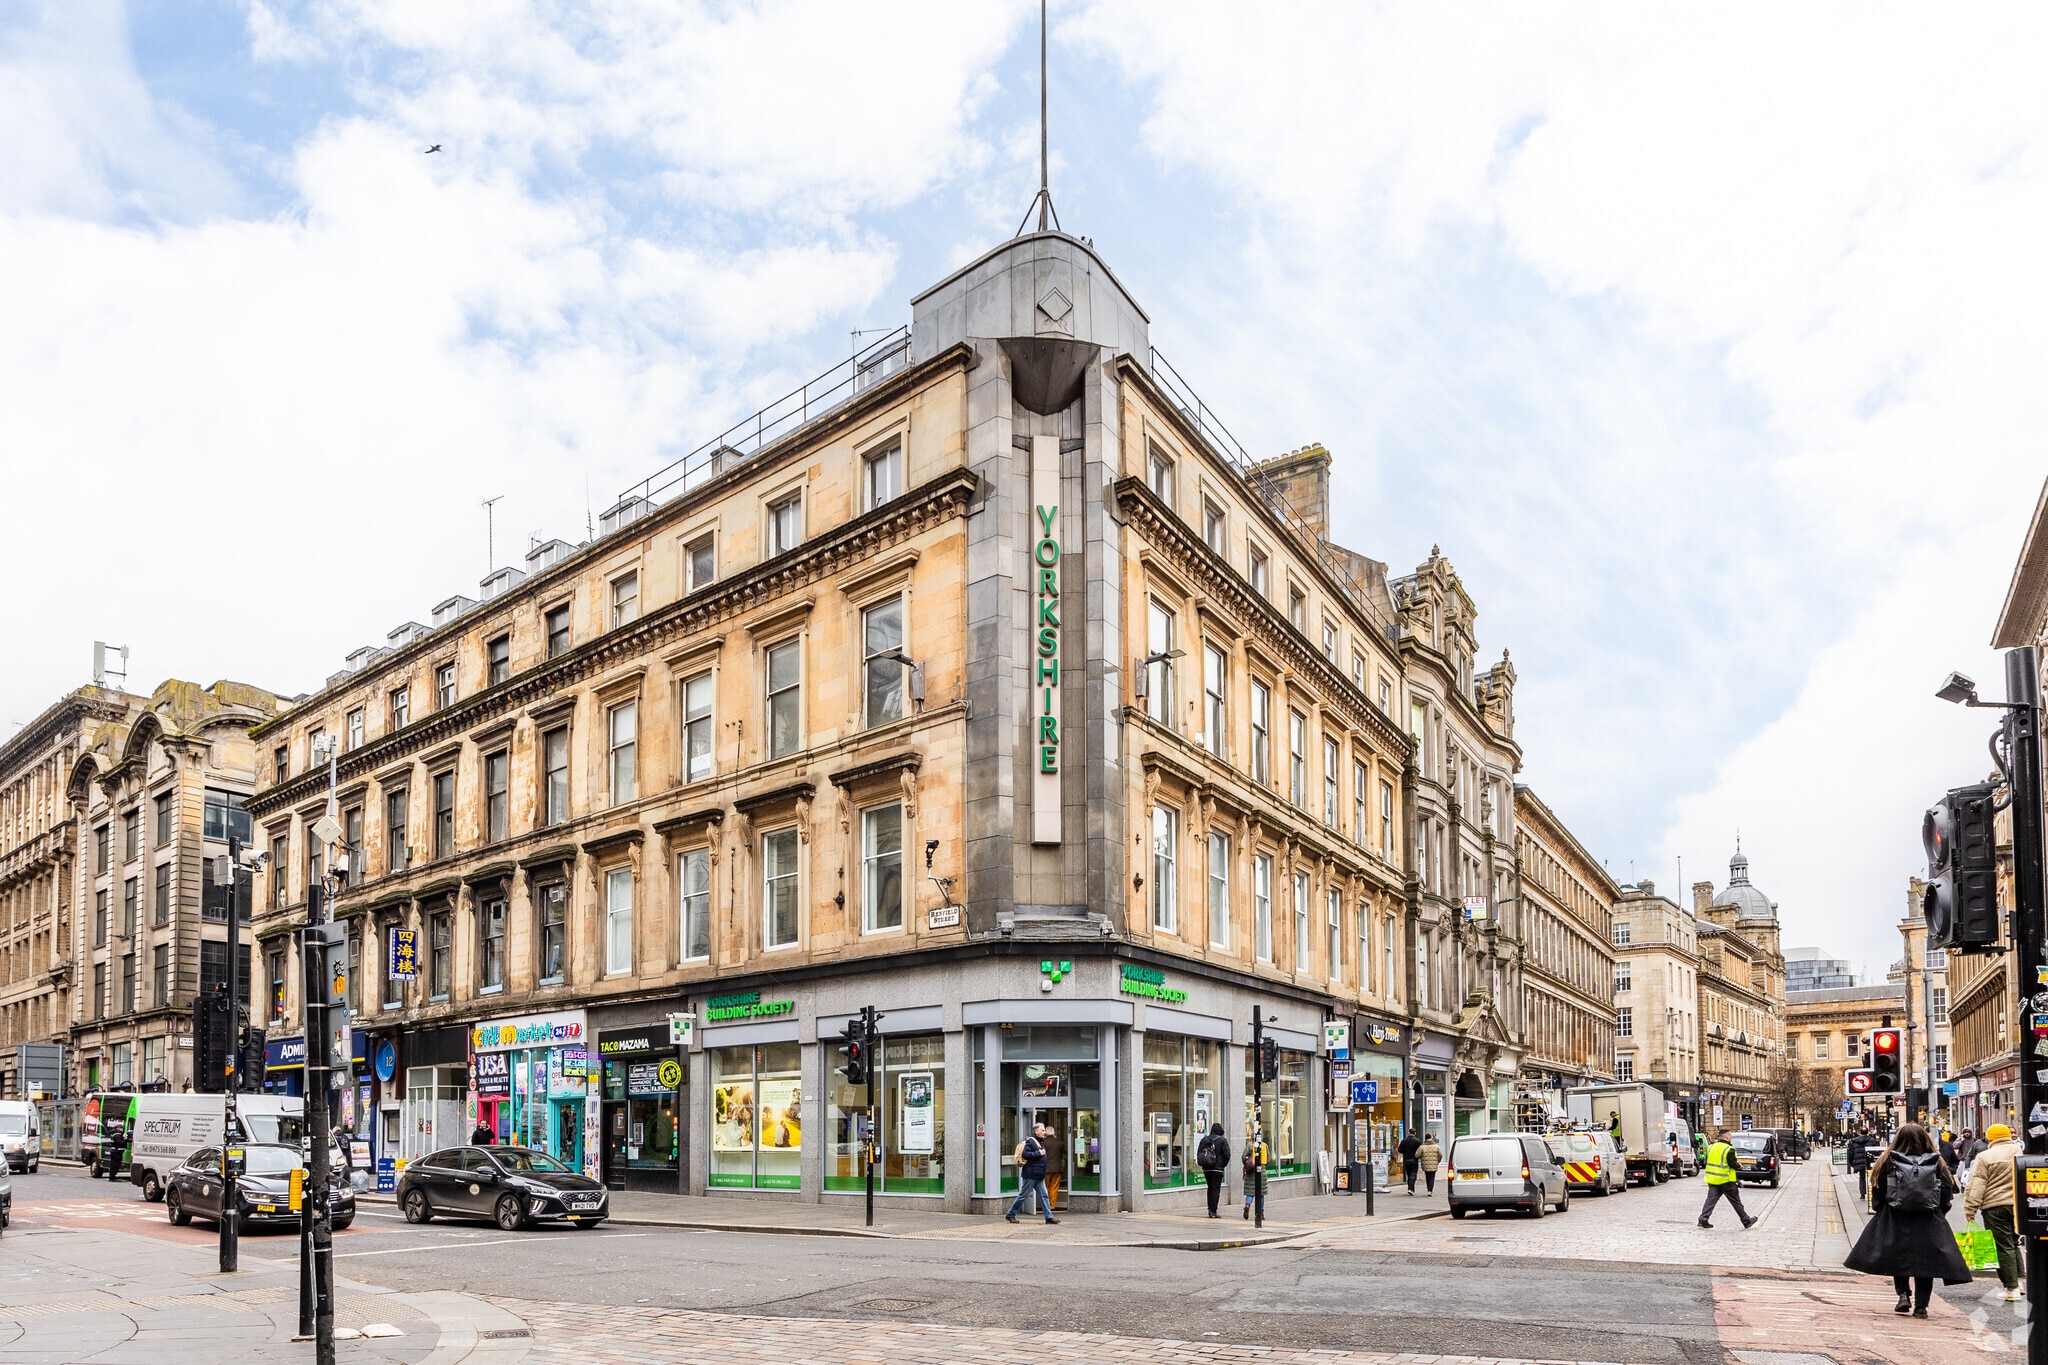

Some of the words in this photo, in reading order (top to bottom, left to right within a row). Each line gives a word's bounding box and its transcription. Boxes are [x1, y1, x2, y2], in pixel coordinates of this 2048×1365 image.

[1036, 505, 1060, 774] YORKSHIRE
[930, 908, 958, 918] RENFIELD
[1121, 964, 1166, 984] YORKSHIRE
[1122, 978, 1159, 997] BUILDING
[1160, 986, 1189, 1003] SOCIETY
[706, 992, 760, 1008] YORKSHIRE
[706, 1005, 750, 1021] BUILDING
[751, 1001, 794, 1017] SOCIETY
[1385, 1027, 1399, 1042] Travel
[280, 1043, 305, 1059] ADMI
[386, 1056, 393, 1066] 12
[477, 1053, 509, 1076] USA
[143, 1121, 181, 1133] SPECTRUM
